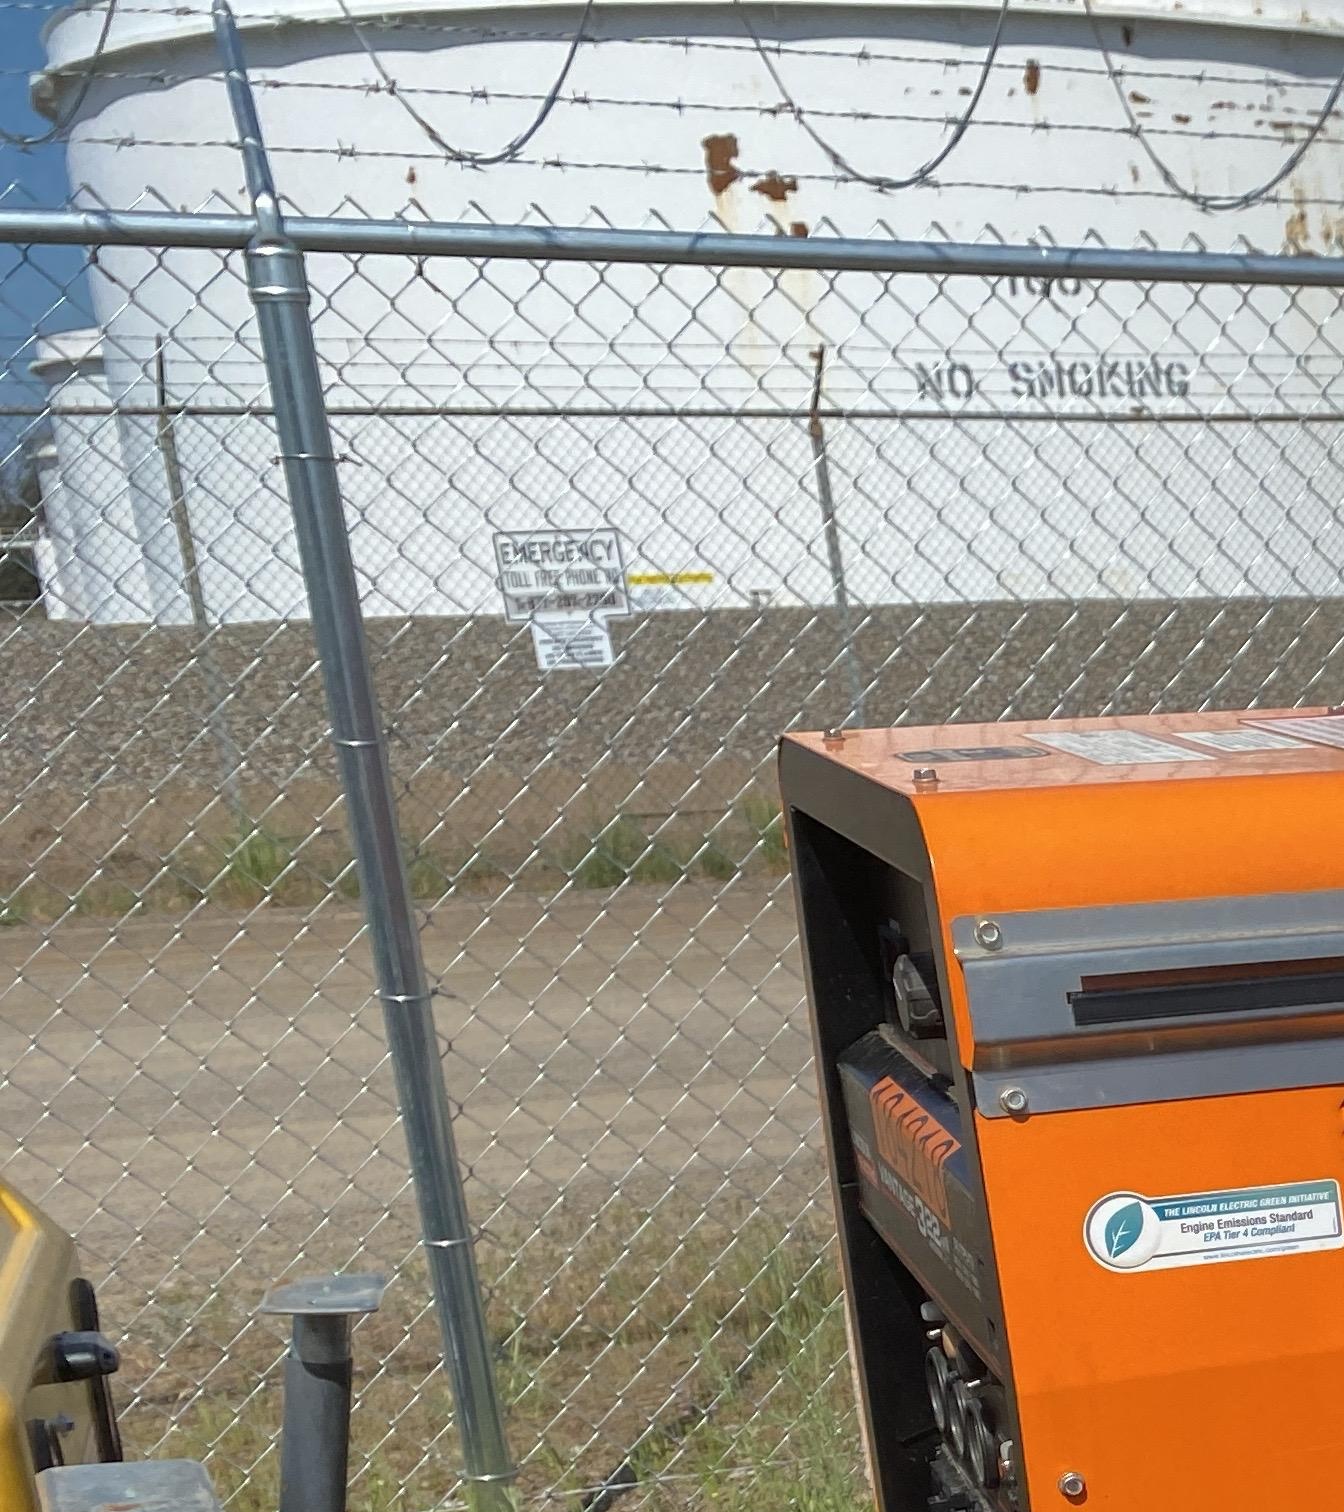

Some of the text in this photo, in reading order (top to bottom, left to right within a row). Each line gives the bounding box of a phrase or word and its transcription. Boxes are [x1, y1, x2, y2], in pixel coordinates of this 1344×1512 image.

[916, 360, 1188, 398] NO SMOKING
[500, 539, 615, 564] EMERGENCY
[1164, 1191, 1330, 1218] THE LINCOLN ELECTRIC GREEN INITIATIVE
[1180, 1209, 1314, 1235] Engine Emissions Standard
[1203, 1223, 1295, 1242] EPA Tier 4 Compliant
